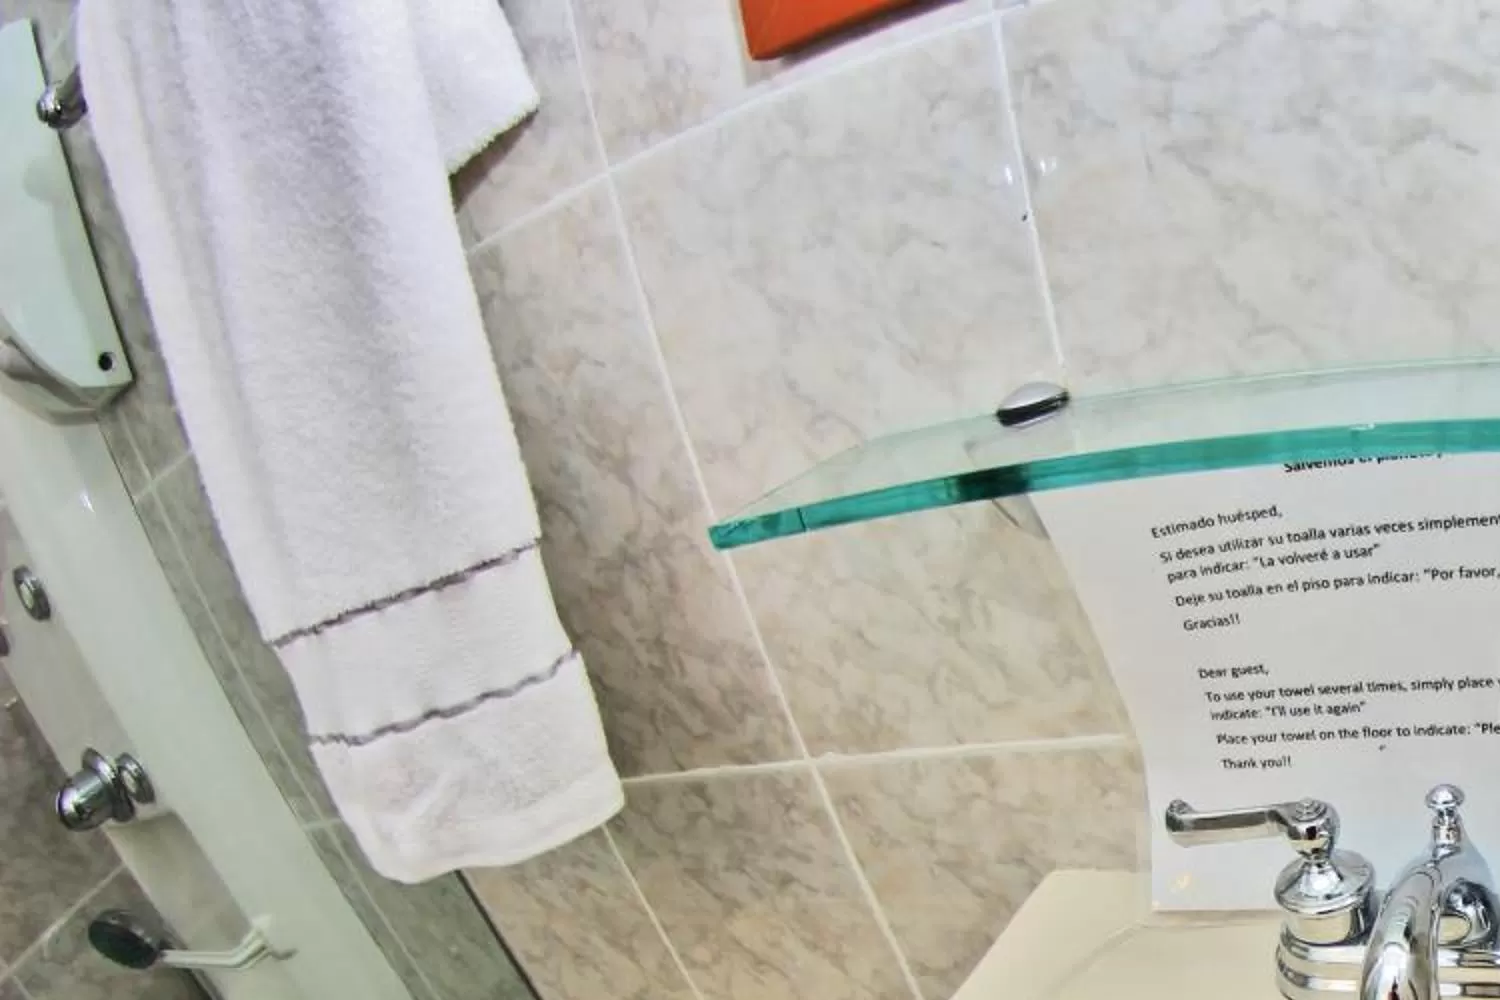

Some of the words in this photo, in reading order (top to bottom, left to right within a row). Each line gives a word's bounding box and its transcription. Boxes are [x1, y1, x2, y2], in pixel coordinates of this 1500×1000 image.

[1150, 516, 1215, 539] Estimado
[1217, 505, 1284, 526] huésped,
[1159, 551, 1173, 564] Si
[1175, 544, 1216, 562] desea
[1217, 538, 1264, 554] utilizar
[1267, 534, 1284, 547] su
[1286, 528, 1326, 544] toalla
[1328, 523, 1371, 538] varias
[1373, 520, 1415, 535] veces
[1166, 568, 1198, 584] para
[1200, 559, 1249, 577] indicar:
[1277, 546, 1330, 565] volveré
[1331, 550, 1342, 560] a
[1175, 593, 1206, 607] Deje
[1207, 591, 1224, 602] su
[1225, 584, 1263, 599] toalla
[1266, 584, 1284, 595] en
[1286, 580, 1300, 593] el
[1301, 577, 1331, 593] piso
[1333, 575, 1365, 591] para
[1367, 571, 1421, 586] indicar:
[1458, 565, 1500, 579] favor,
[1183, 613, 1241, 631] Gracias!!
[1198, 667, 1228, 680] Dear
[1230, 663, 1269, 678] guest,
[1205, 691, 1221, 703] To
[1223, 690, 1245, 701] use
[1246, 688, 1277, 702] your
[1278, 684, 1315, 698] towel
[1316, 681, 1364, 695] several
[1366, 679, 1408, 693] times,
[1410, 677, 1455, 691] simply
[1457, 676, 1495, 690] place
[1210, 707, 1262, 721] indicate:
[1289, 705, 1311, 717] use
[1313, 702, 1324, 715] it
[1216, 732, 1249, 745] Place
[1250, 731, 1279, 746] your
[1280, 729, 1317, 742] towel
[1318, 730, 1336, 740] on
[1337, 727, 1359, 739] the
[1361, 725, 1393, 739] floor
[1395, 726, 1411, 737] to
[1413, 723, 1471, 737] indicate:
[1220, 756, 1258, 770] Thank
[1259, 755, 1293, 771] you!!
